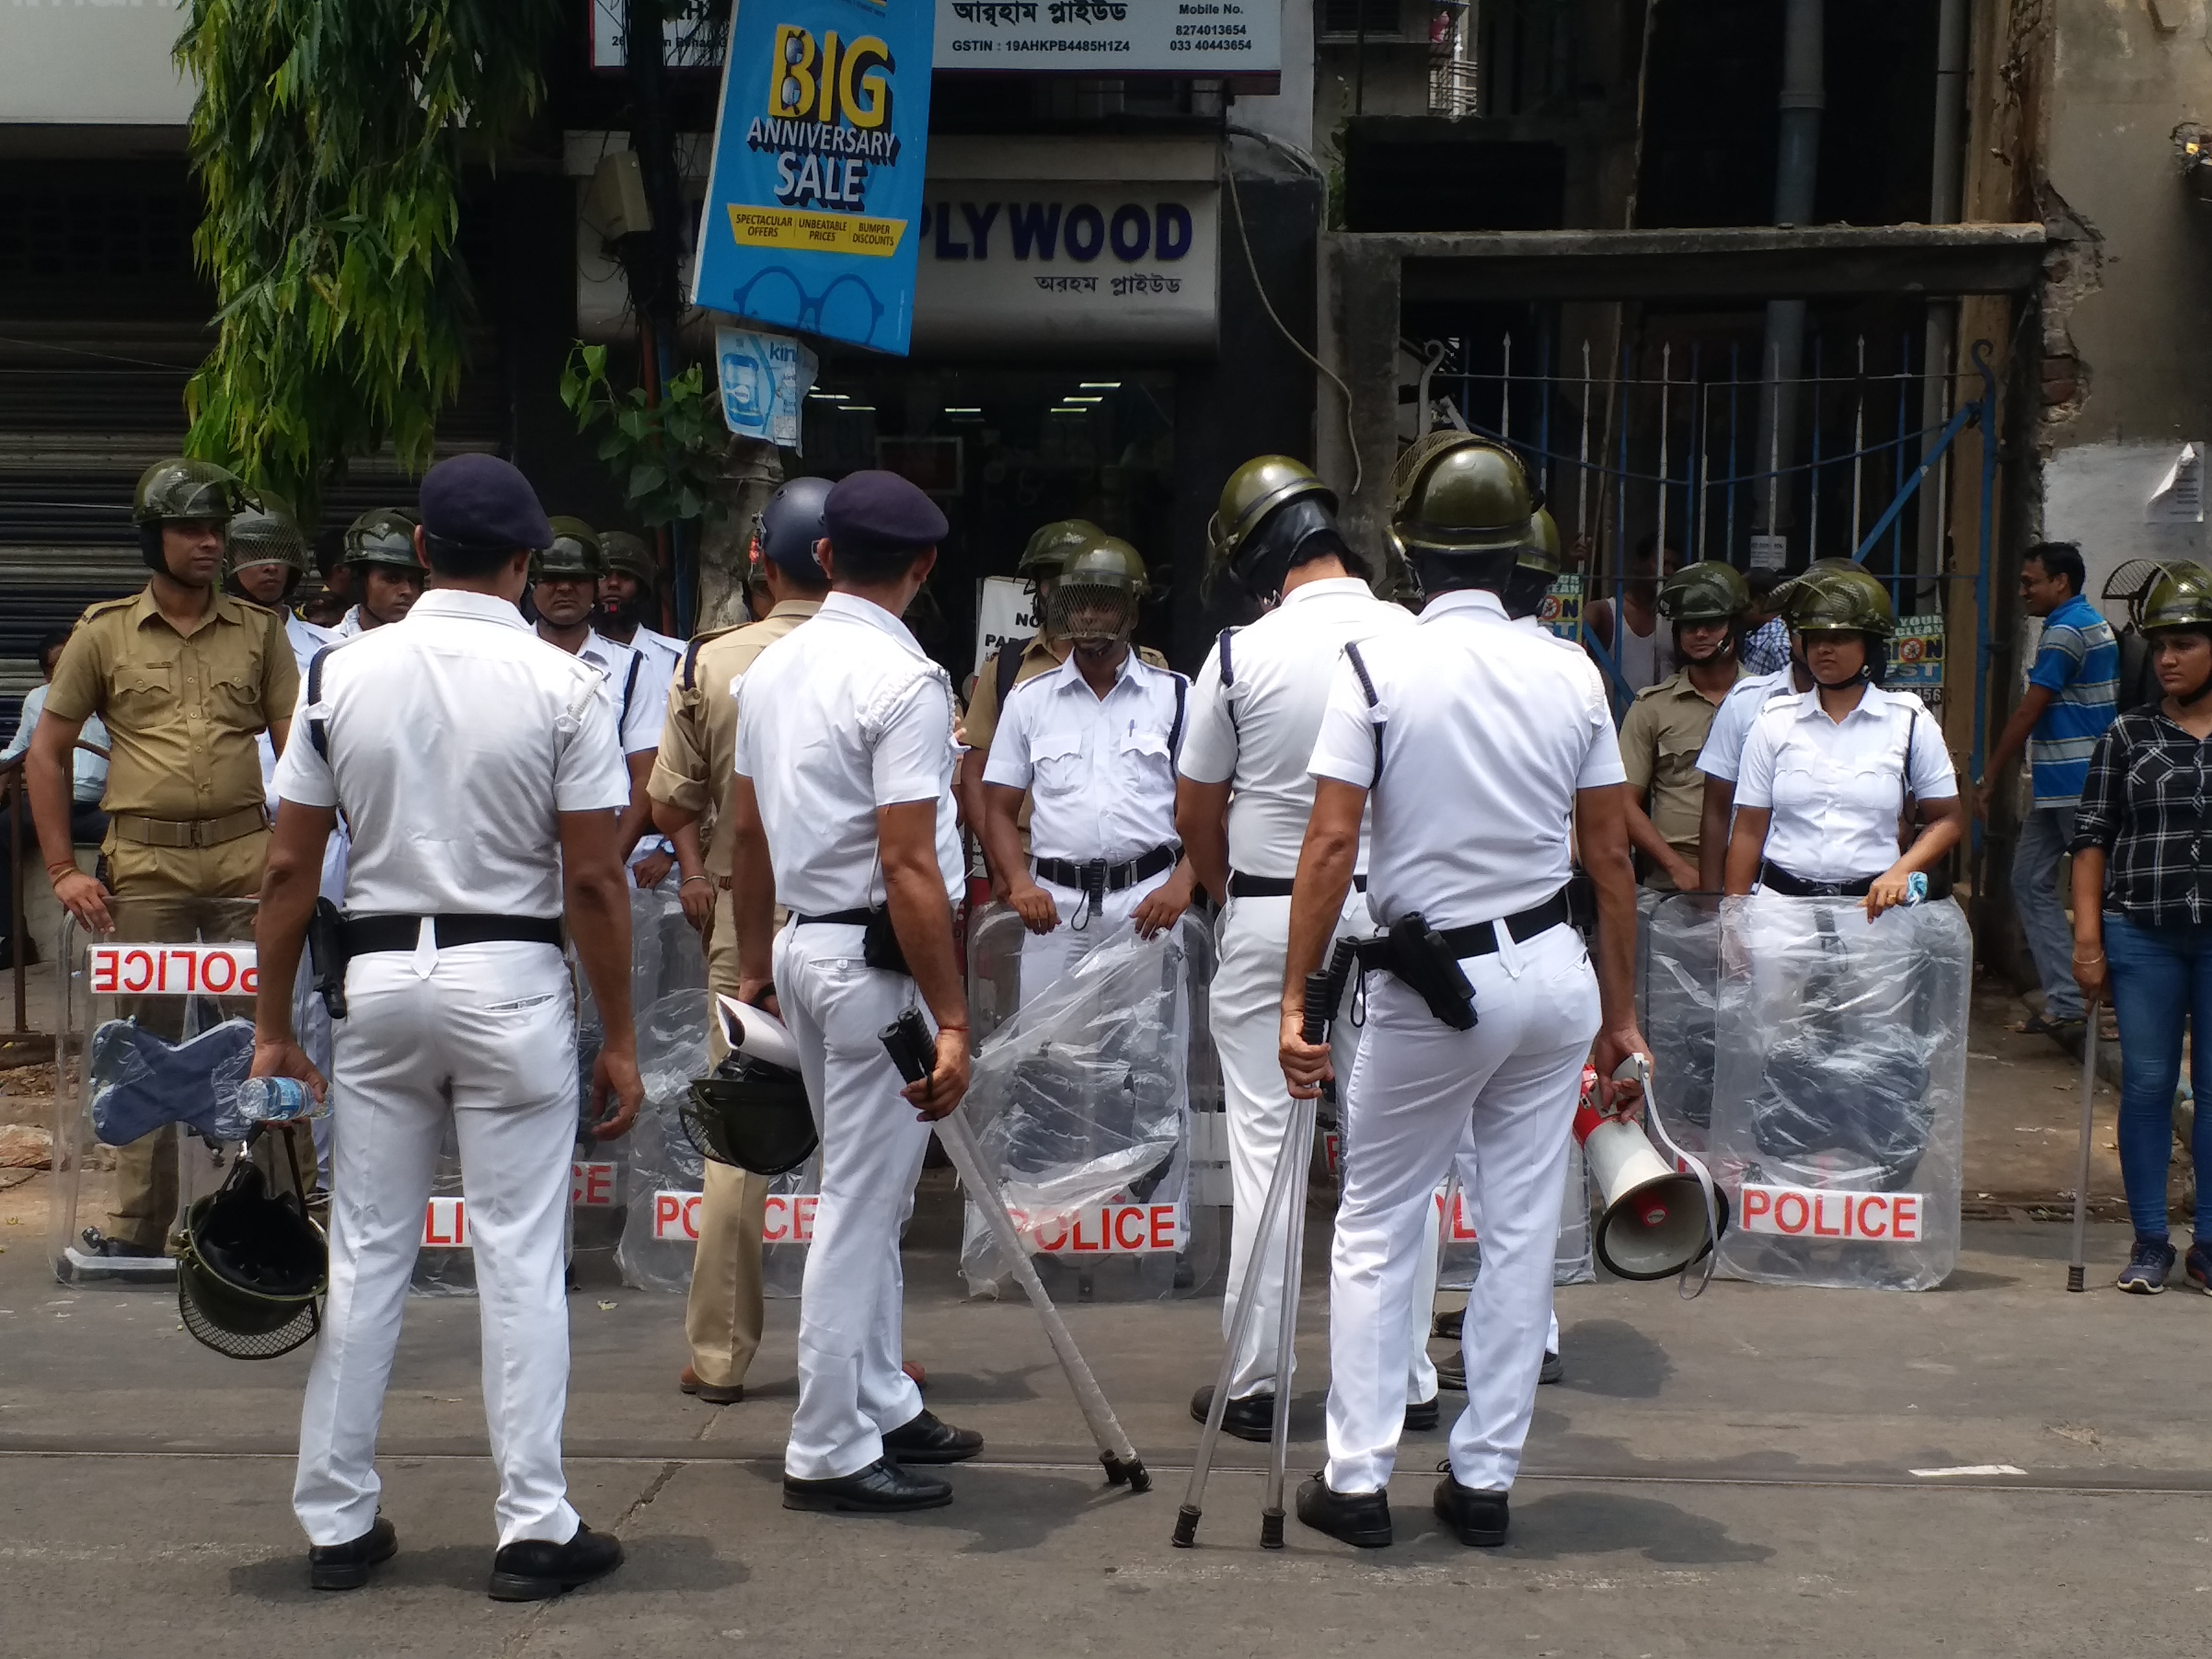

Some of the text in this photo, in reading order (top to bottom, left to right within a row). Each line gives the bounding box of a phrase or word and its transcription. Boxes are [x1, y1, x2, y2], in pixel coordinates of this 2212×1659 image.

[1179, 4, 1243, 14] Mobile No.
[1176, 25, 1247, 36] 8274013654
[952, 40, 993, 51] GSTIN
[1006, 40, 1130, 51] 19AHKPB4485H1Z4
[1170, 39, 1252, 51] 033 40443654
[769, 24, 889, 129] BIG
[746, 116, 896, 157] ANNIVERSARY
[773, 151, 863, 203] SALE
[736, 214, 793, 227] SPECTACULAR
[799, 217, 847, 231] UNBEATABLE
[747, 226, 779, 238] OFFERS
[858, 222, 890, 234] BUMPER
[809, 230, 836, 242] PRICES
[852, 233, 894, 247] DISCOUNTS
[1033, 273, 1182, 296] অরহম প্লাইউড
[1899, 615, 1944, 627] YOUR
[1895, 624, 1944, 637] CLEAN
[1742, 1189, 1917, 1239] POLICE
